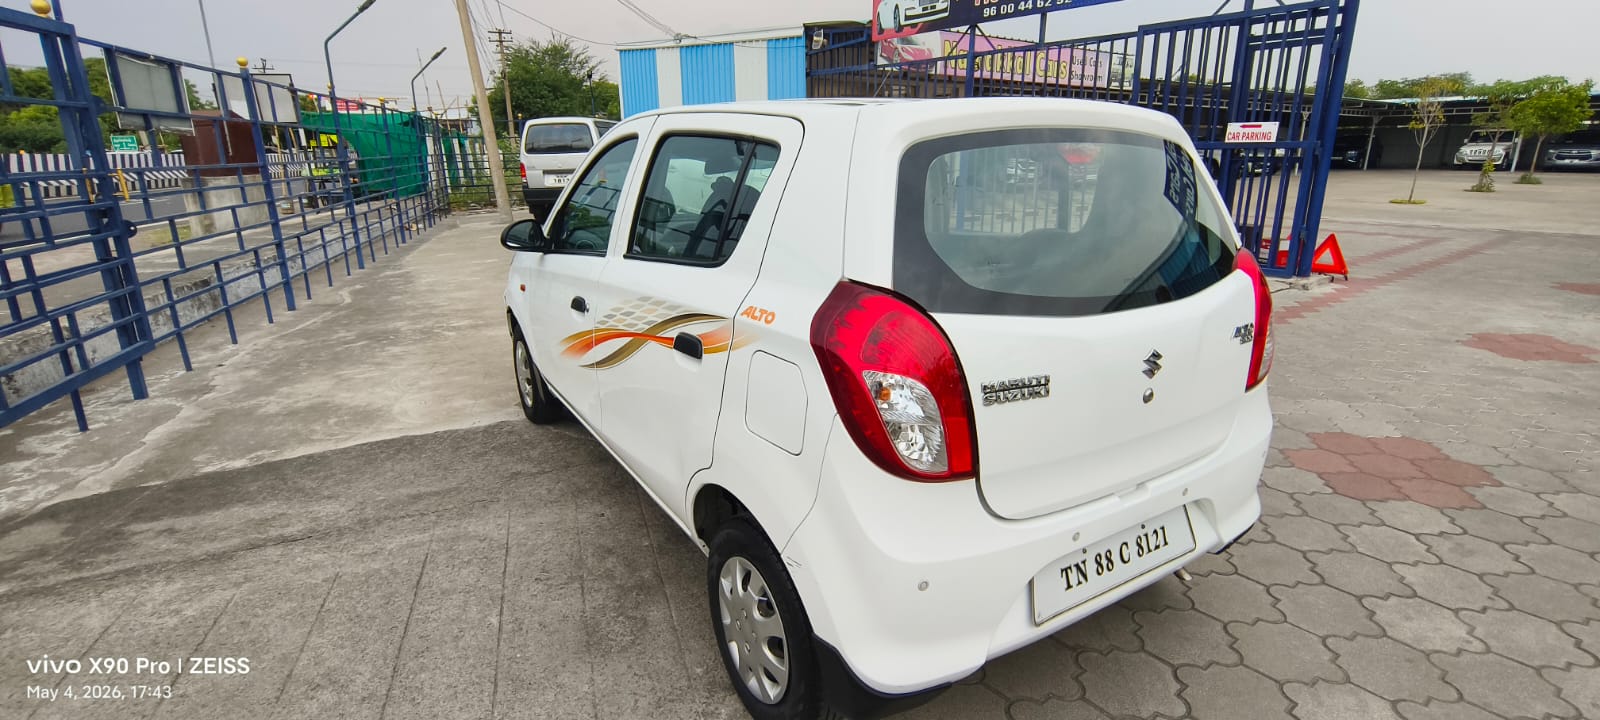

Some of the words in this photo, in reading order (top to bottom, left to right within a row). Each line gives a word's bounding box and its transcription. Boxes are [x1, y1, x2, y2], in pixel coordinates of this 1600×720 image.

[983, 7, 997, 17] 96
[1000, 3, 1015, 15] 00
[1018, 1, 1033, 11] 44
[1227, 132, 1241, 141] CAR
[1242, 131, 1272, 141] PARKING
[740, 305, 776, 325] ALTO
[981, 374, 1051, 394] MARUTI
[982, 384, 1050, 407] SUZUKI
[1060, 558, 1089, 592] TN
[1094, 548, 1115, 576] 88
[1119, 541, 1131, 565] C
[1135, 525, 1169, 557] 8121
